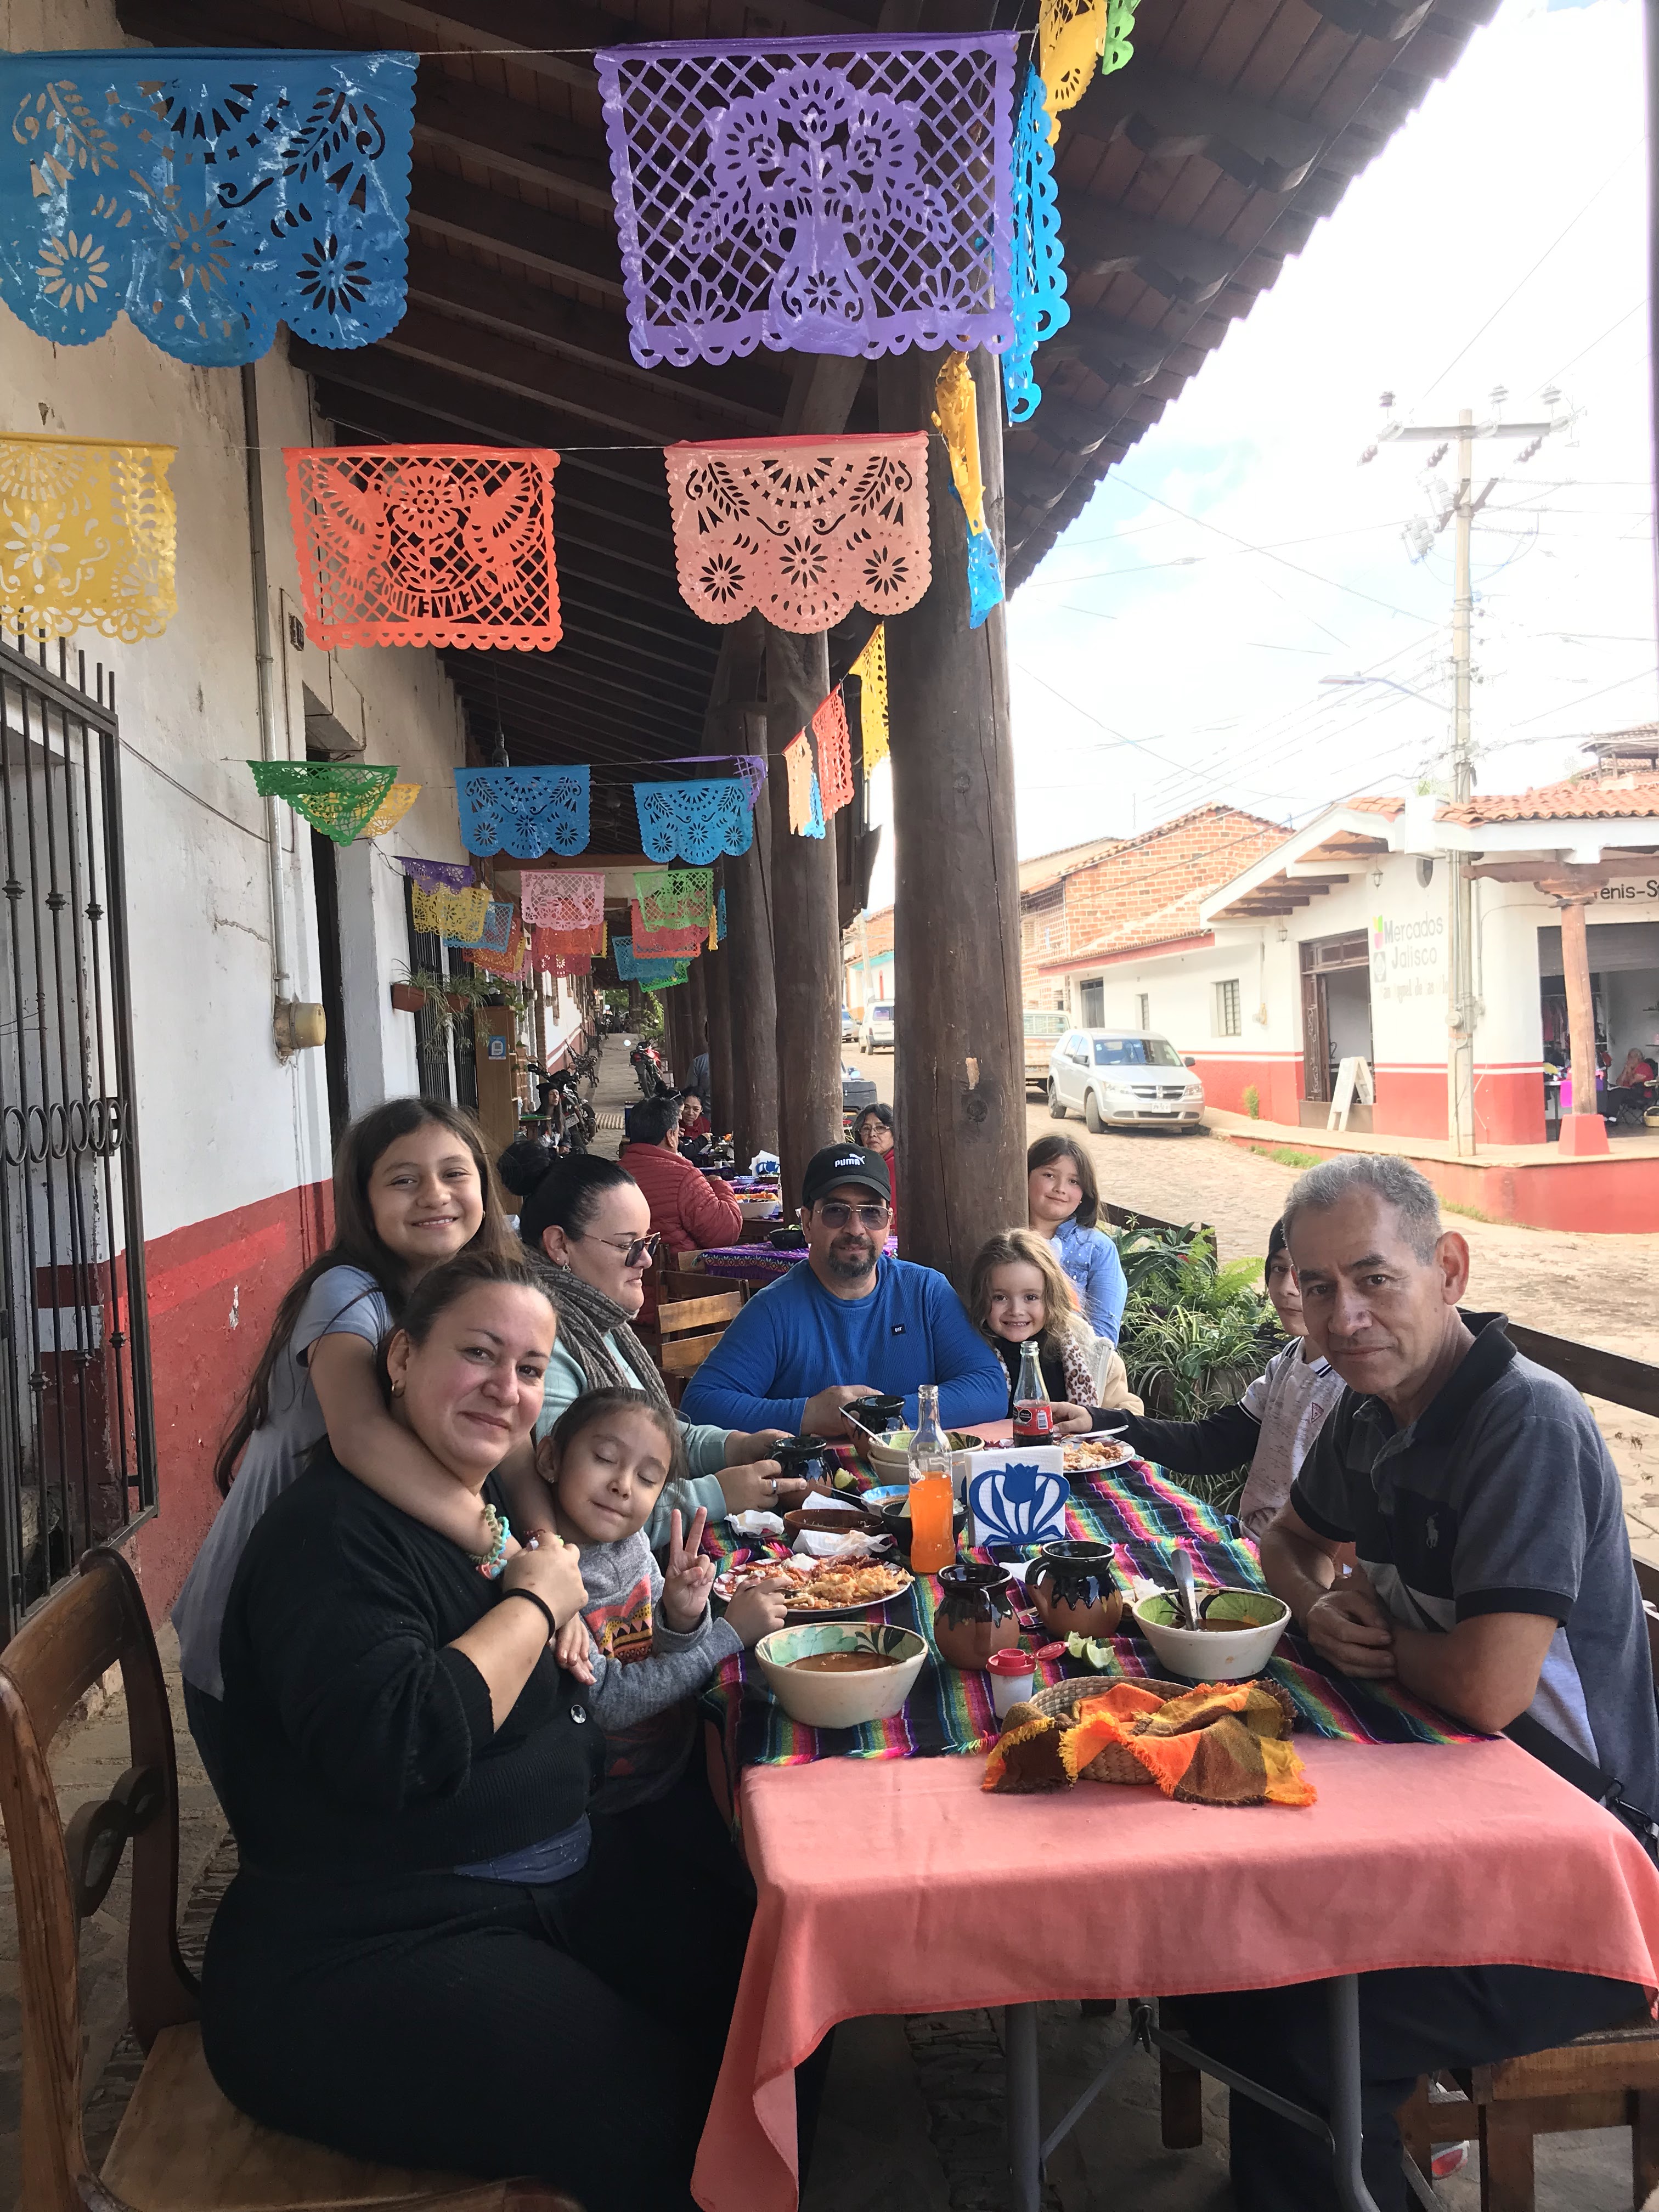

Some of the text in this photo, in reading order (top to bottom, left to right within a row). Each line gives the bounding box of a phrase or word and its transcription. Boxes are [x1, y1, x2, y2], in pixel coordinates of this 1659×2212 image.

[1383, 911, 1443, 944] Mercados
[1391, 944, 1437, 970] Jalisco
[834, 1158, 860, 1167] PUMA
